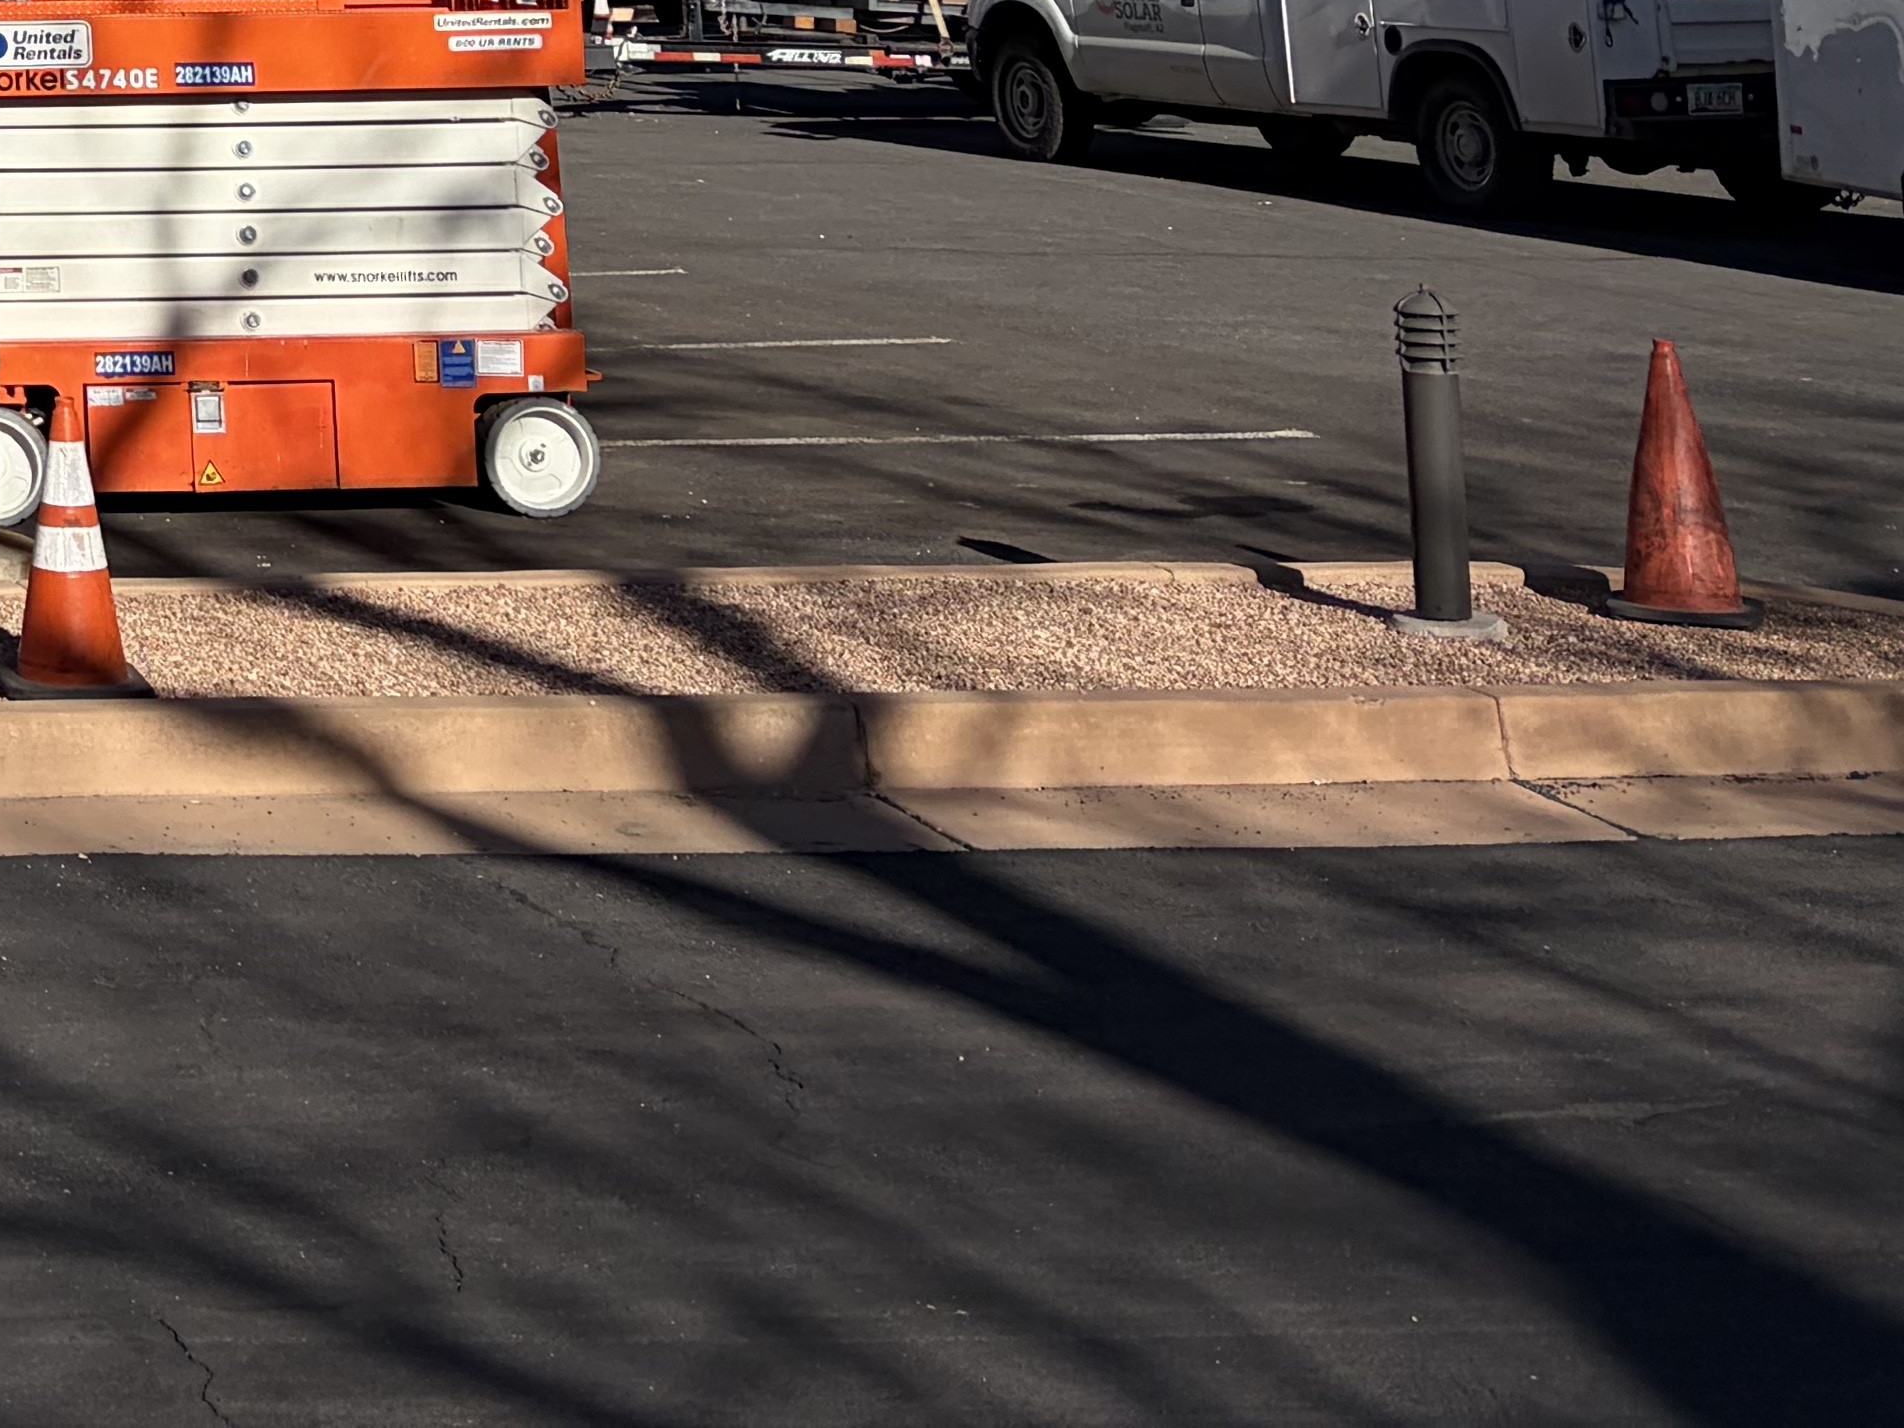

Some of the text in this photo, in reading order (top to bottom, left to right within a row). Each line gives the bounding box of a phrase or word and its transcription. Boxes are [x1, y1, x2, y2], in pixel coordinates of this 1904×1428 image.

[1114, 2, 1164, 21] SOLAR
[13, 29, 76, 45] United
[13, 45, 83, 61] Rentals
[65, 68, 159, 90] S4740E
[175, 65, 253, 84] 282139AH
[313, 270, 458, 283] www.snorkellifts.com
[95, 354, 173, 374] 282139AH
